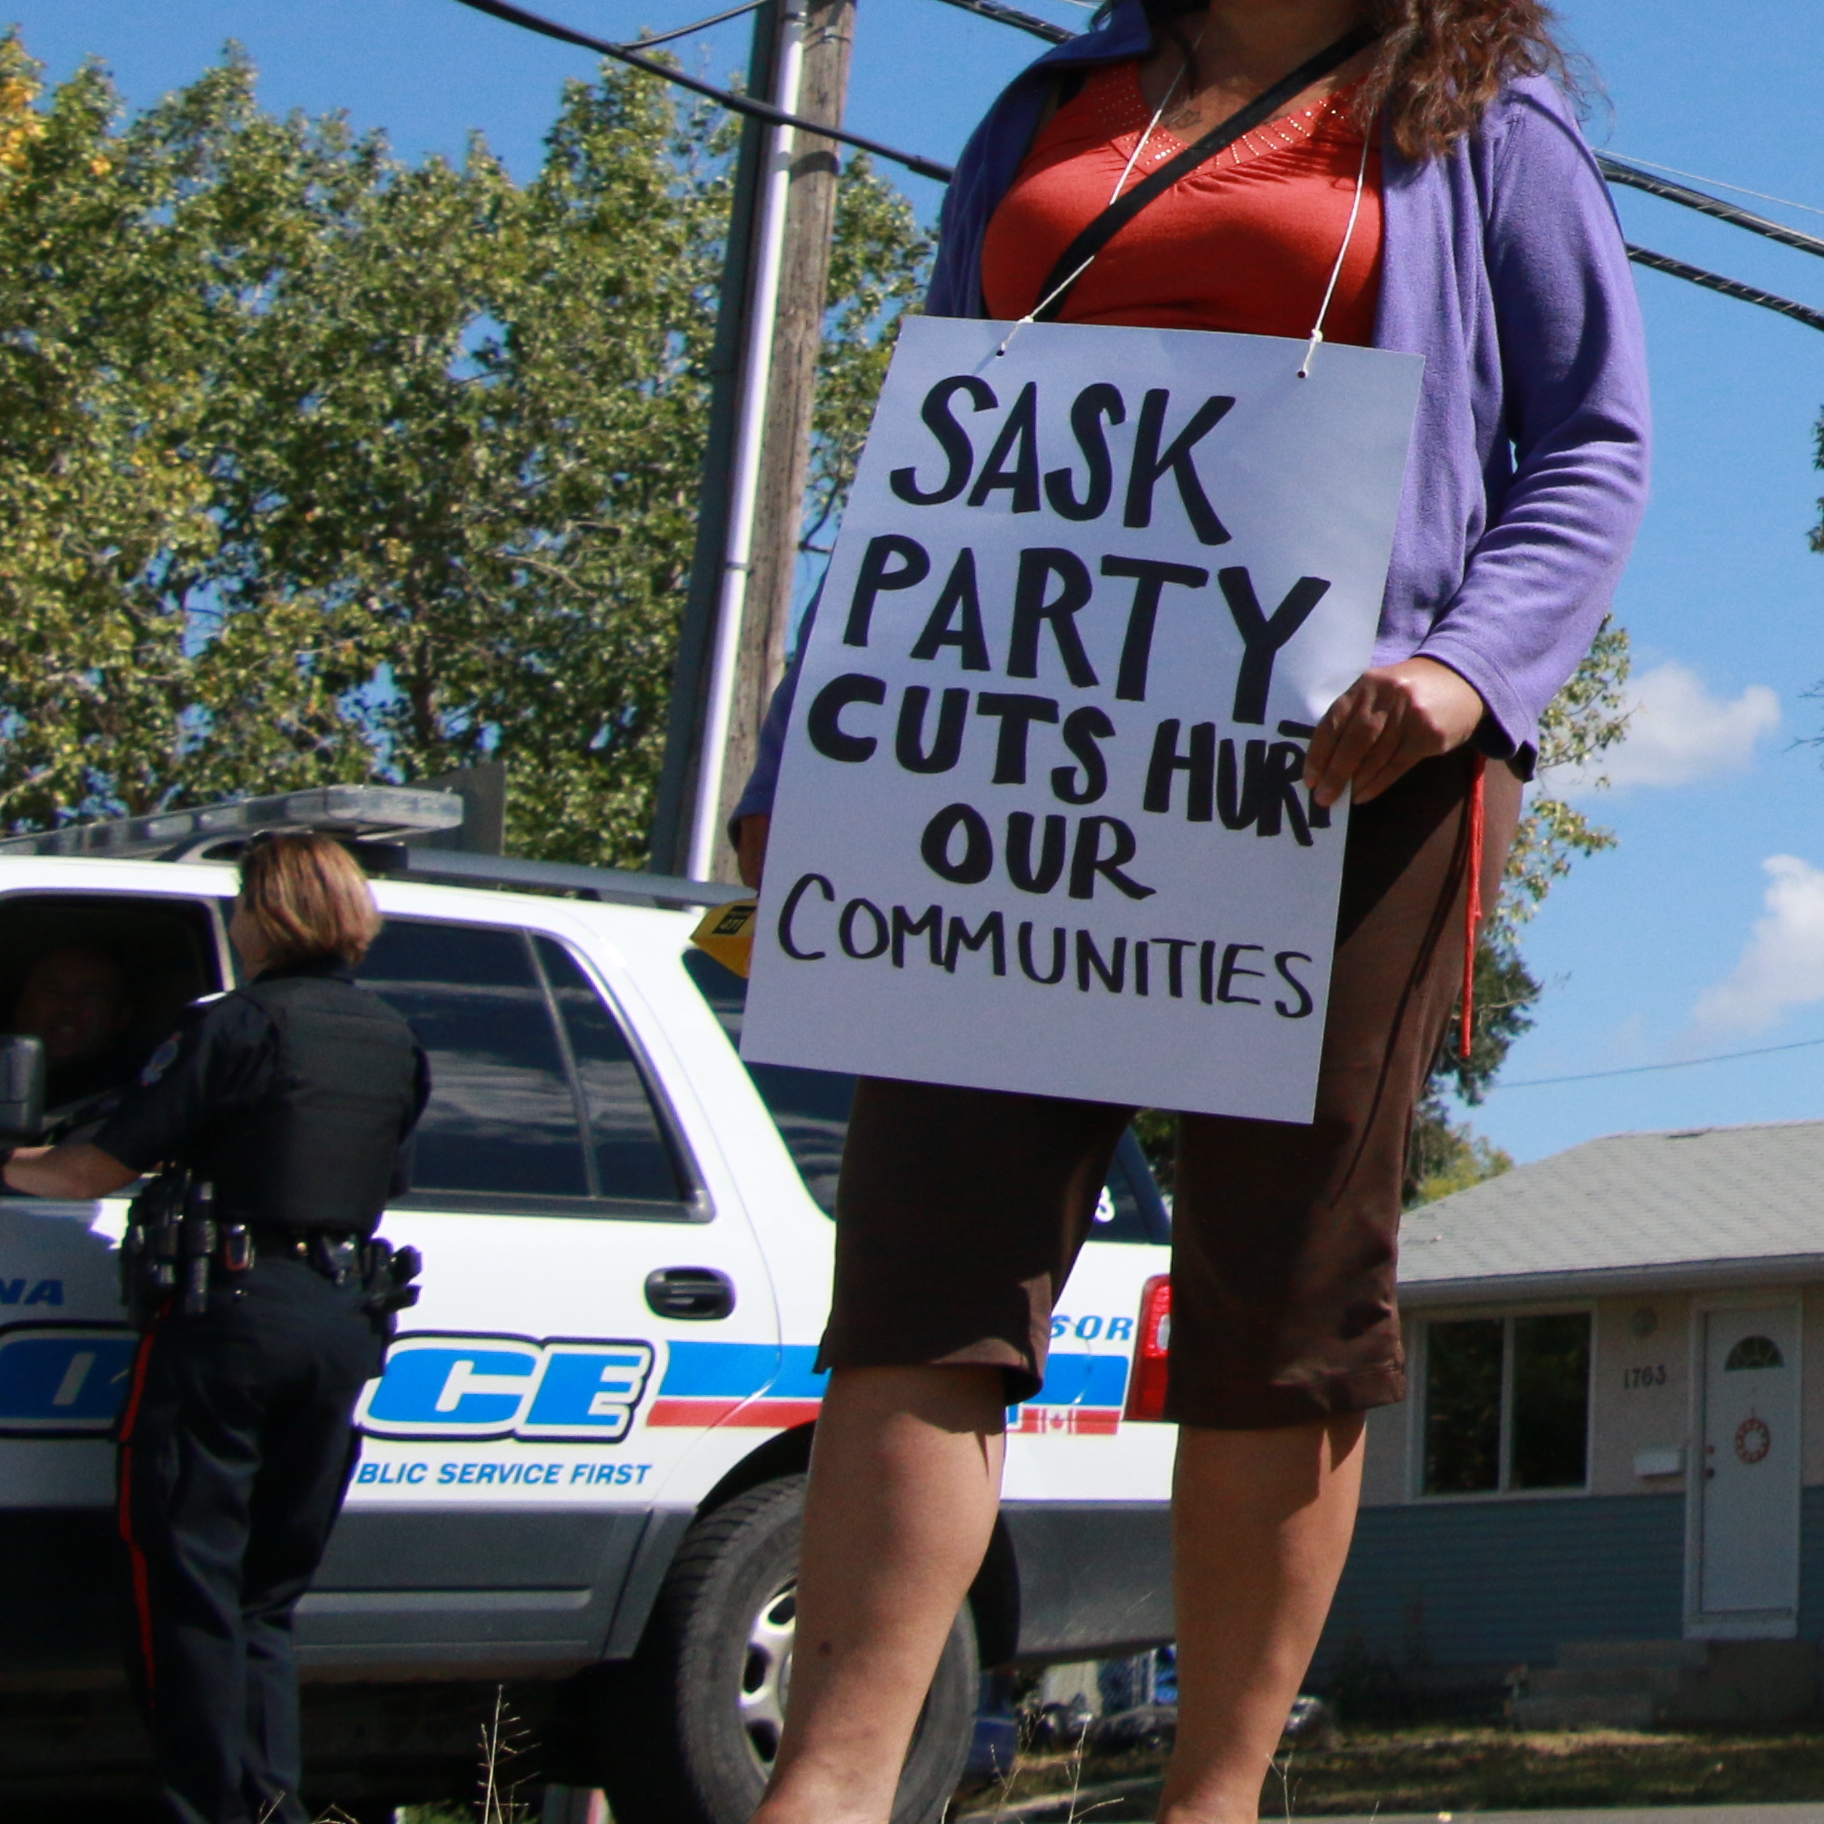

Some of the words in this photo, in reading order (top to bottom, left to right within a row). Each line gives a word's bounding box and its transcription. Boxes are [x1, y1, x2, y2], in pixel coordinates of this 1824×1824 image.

[889, 374, 1236, 545] SASK
[842, 534, 1331, 725] PARTY
[806, 672, 1117, 806] CUTS
[920, 802, 1157, 901] OUR
[778, 872, 1314, 1019] COMMUNITIES
[437, 1462, 564, 1486] SERVICE
[569, 1463, 653, 1486] FIRST
